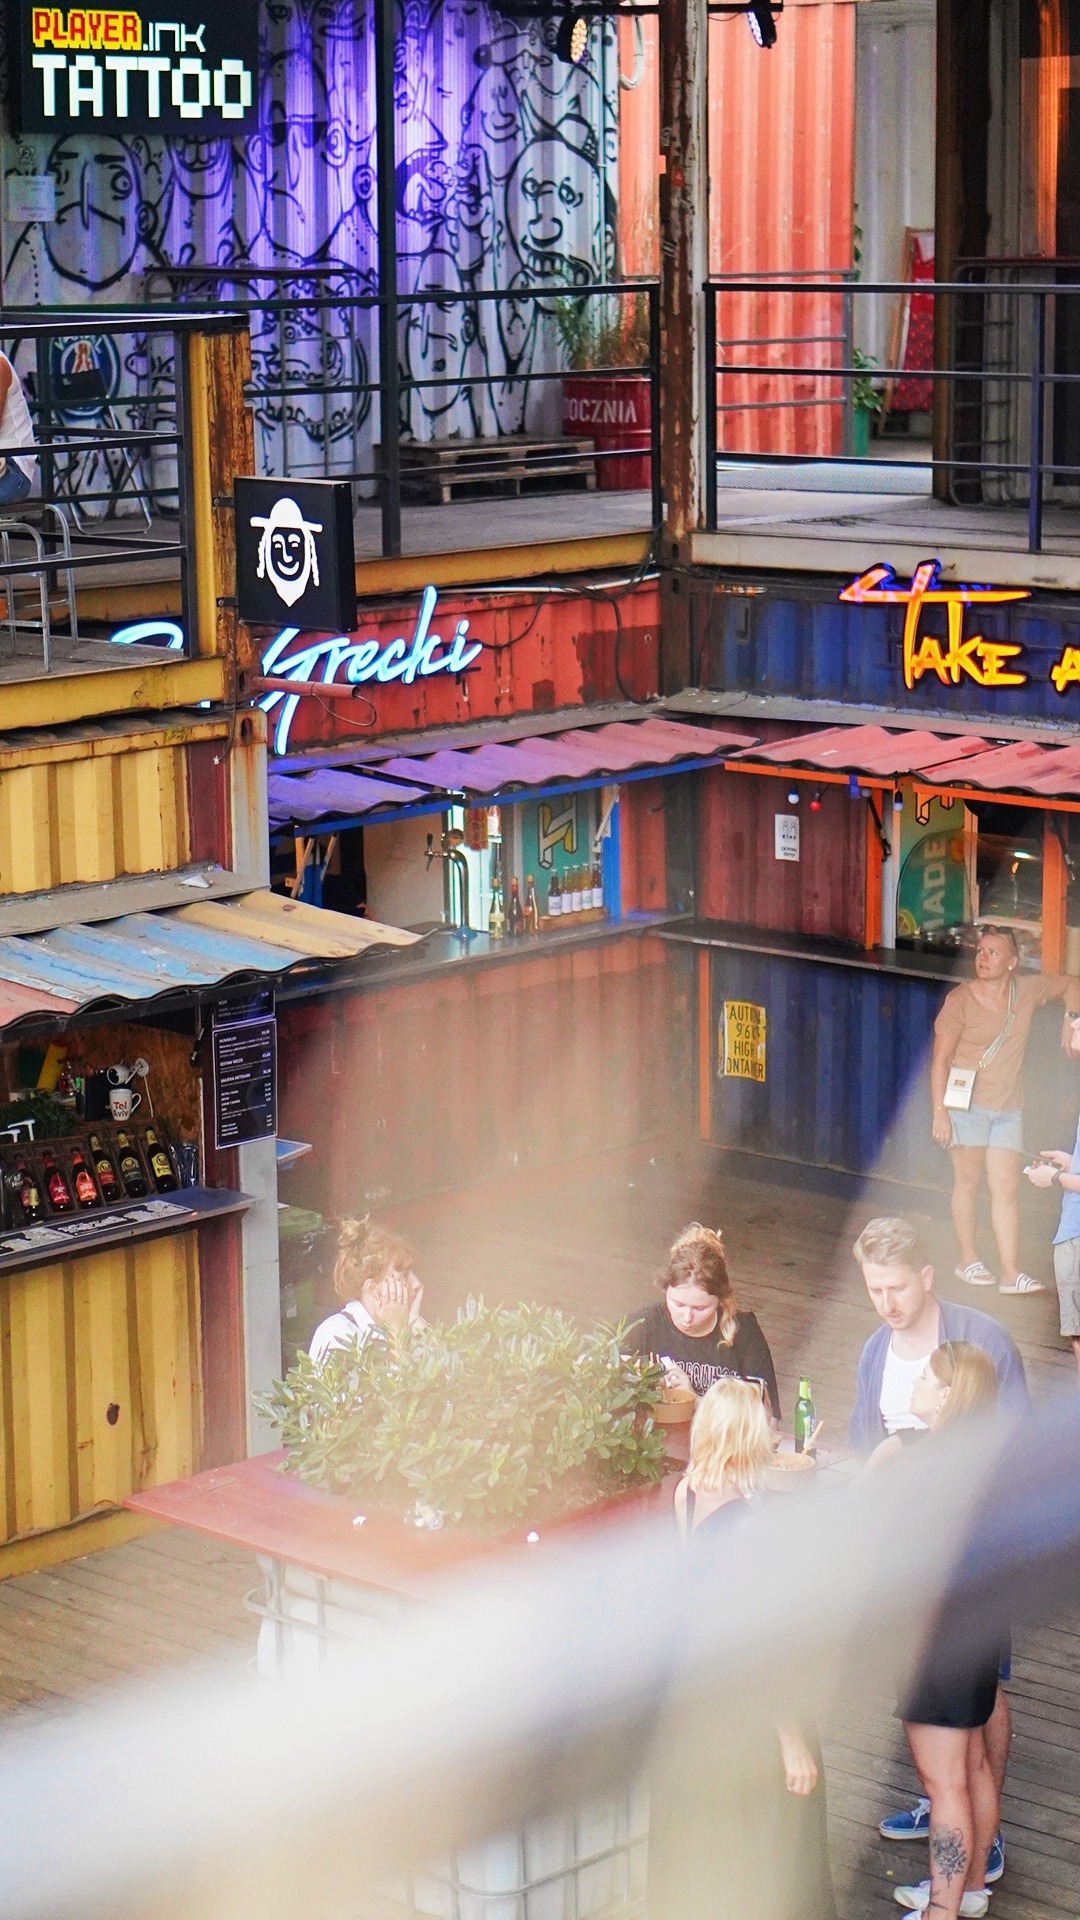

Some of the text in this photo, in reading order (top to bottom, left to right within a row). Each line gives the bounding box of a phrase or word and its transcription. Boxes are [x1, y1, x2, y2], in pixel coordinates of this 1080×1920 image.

[32, 54, 252, 118] TATTOO
[564, 398, 637, 424] OCZNIA
[838, 562, 1032, 690] TAKE
[113, 1102, 127, 1110] Tel
